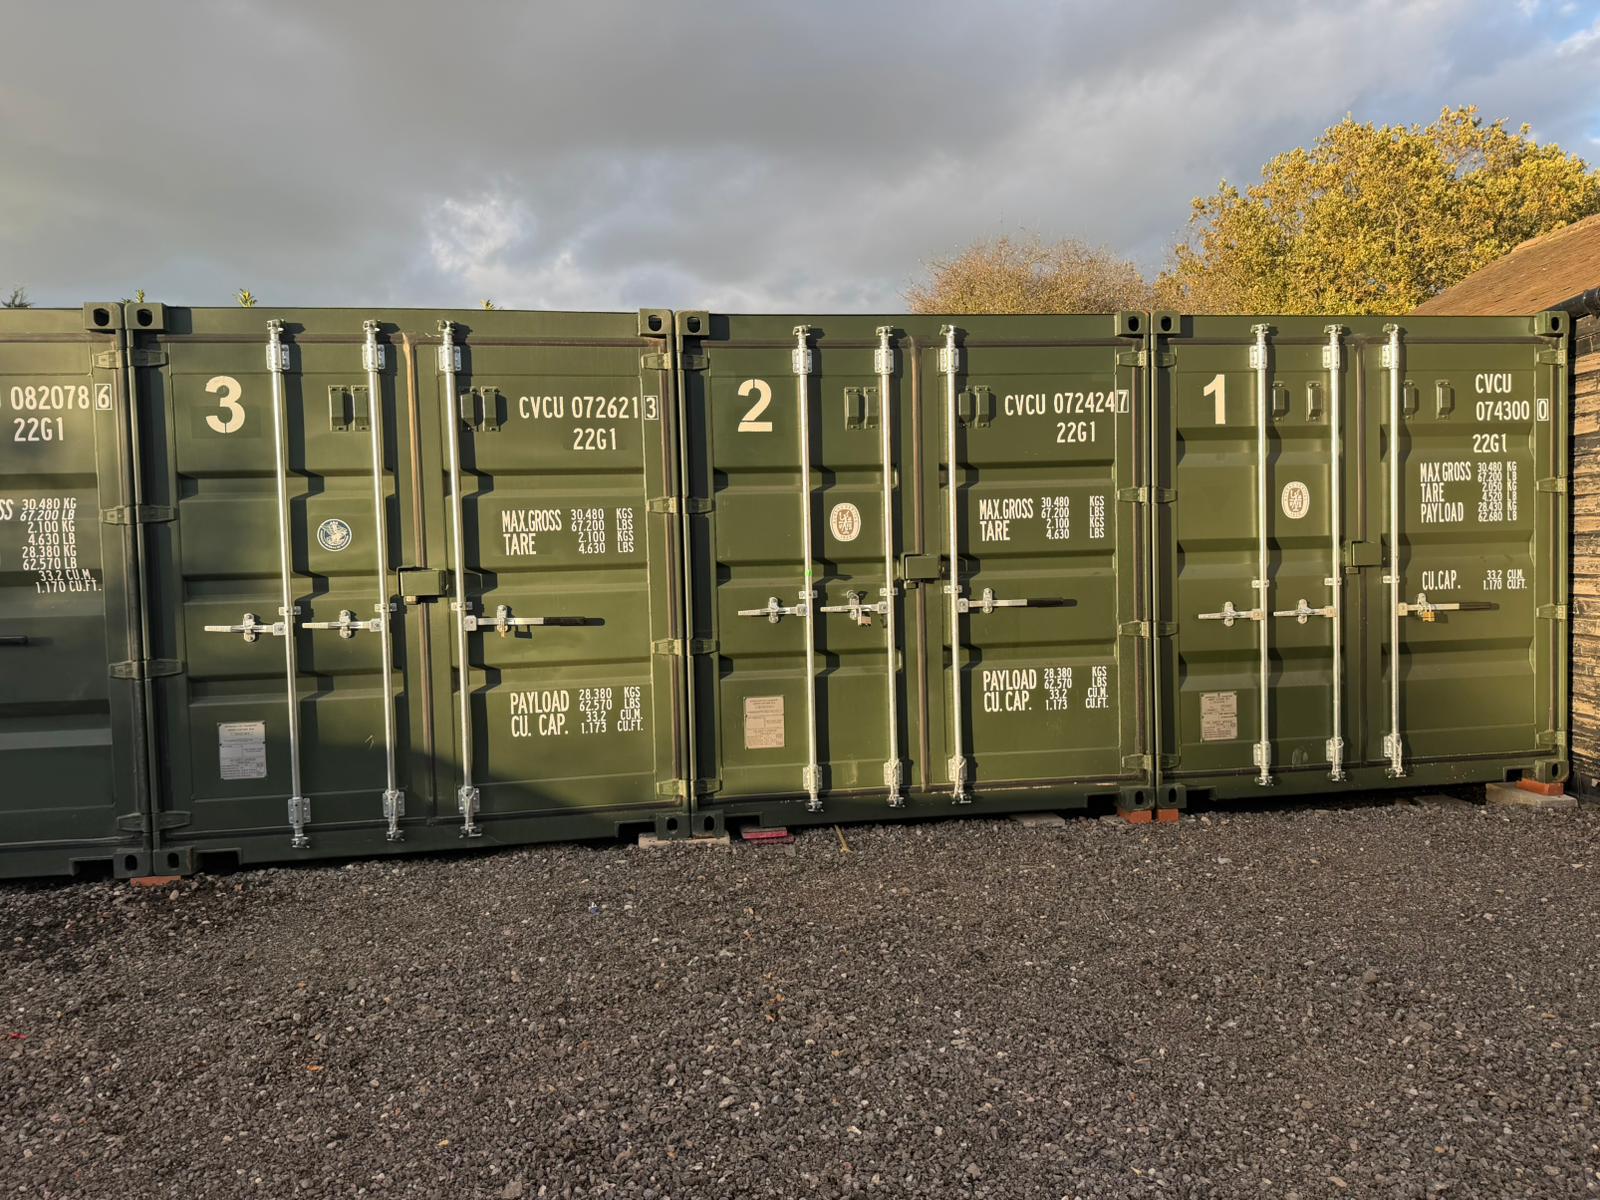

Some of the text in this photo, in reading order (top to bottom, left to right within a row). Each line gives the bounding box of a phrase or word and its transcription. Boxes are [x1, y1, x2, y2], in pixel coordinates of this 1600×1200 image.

[1475, 374, 1512, 393] CVCU
[10, 385, 90, 410] 082078
[205, 375, 245, 433] 3
[1203, 374, 1225, 424] 1
[519, 396, 564, 419] CVCU
[738, 379, 773, 433] 2
[1004, 393, 1046, 416] CVCU
[1476, 400, 1530, 421] 074300
[14, 417, 64, 441] 22G1
[1056, 421, 1095, 443] 22G1
[573, 428, 617, 450] 22G1
[1472, 434, 1507, 453] 22G1
[1507, 461, 1517, 471] KG
[1507, 471, 1517, 481] LB
[1420, 482, 1445, 502] TARE
[1507, 480, 1517, 491] KG
[1507, 490, 1517, 500] LB
[22, 498, 77, 510] 30.480 KG
[1041, 496, 1104, 508] 30.480 KGS
[1507, 500, 1517, 511] KG
[20, 509, 75, 521] 67.200 LB
[571, 508, 633, 520] 30.480 KGS
[1041, 506, 1104, 518] 67.200 LBS
[1420, 502, 1464, 523] PAYLOAD
[1507, 510, 1517, 521] LB
[27, 520, 75, 533] 2.100 KG
[571, 519, 633, 532] 67.200 LBS
[1046, 517, 1104, 529] 2.100 KGS
[578, 530, 634, 543] 2.100 KGS
[980, 520, 1010, 541] TARE
[1046, 528, 1104, 540] 4.630 LBS
[28, 532, 76, 546] 4.630 LB
[503, 533, 537, 555] TARE
[22, 545, 77, 558] 28.380 KG
[578, 542, 634, 554] 4.630 LBS
[22, 556, 77, 571] 62.570 LB
[40, 569, 95, 582] 33.2 CU.M.
[35, 580, 102, 594] 1.170 CU.FT.
[1044, 666, 1107, 679] 28.380 KGS
[983, 669, 1037, 691] PAYLOAD
[1044, 676, 1107, 689] 62.570 LBS
[579, 687, 641, 700] 28.380 KGS
[1049, 689, 1067, 700] 33.2
[510, 690, 570, 715] PAYLOAD
[579, 698, 641, 711] 62.570 LBS
[1046, 699, 1067, 711] 1.173
[586, 709, 643, 722] 33.2 CU.M.
[511, 713, 569, 737] CU. CAP.
[581, 720, 644, 734] 1.173 CU.FT.
